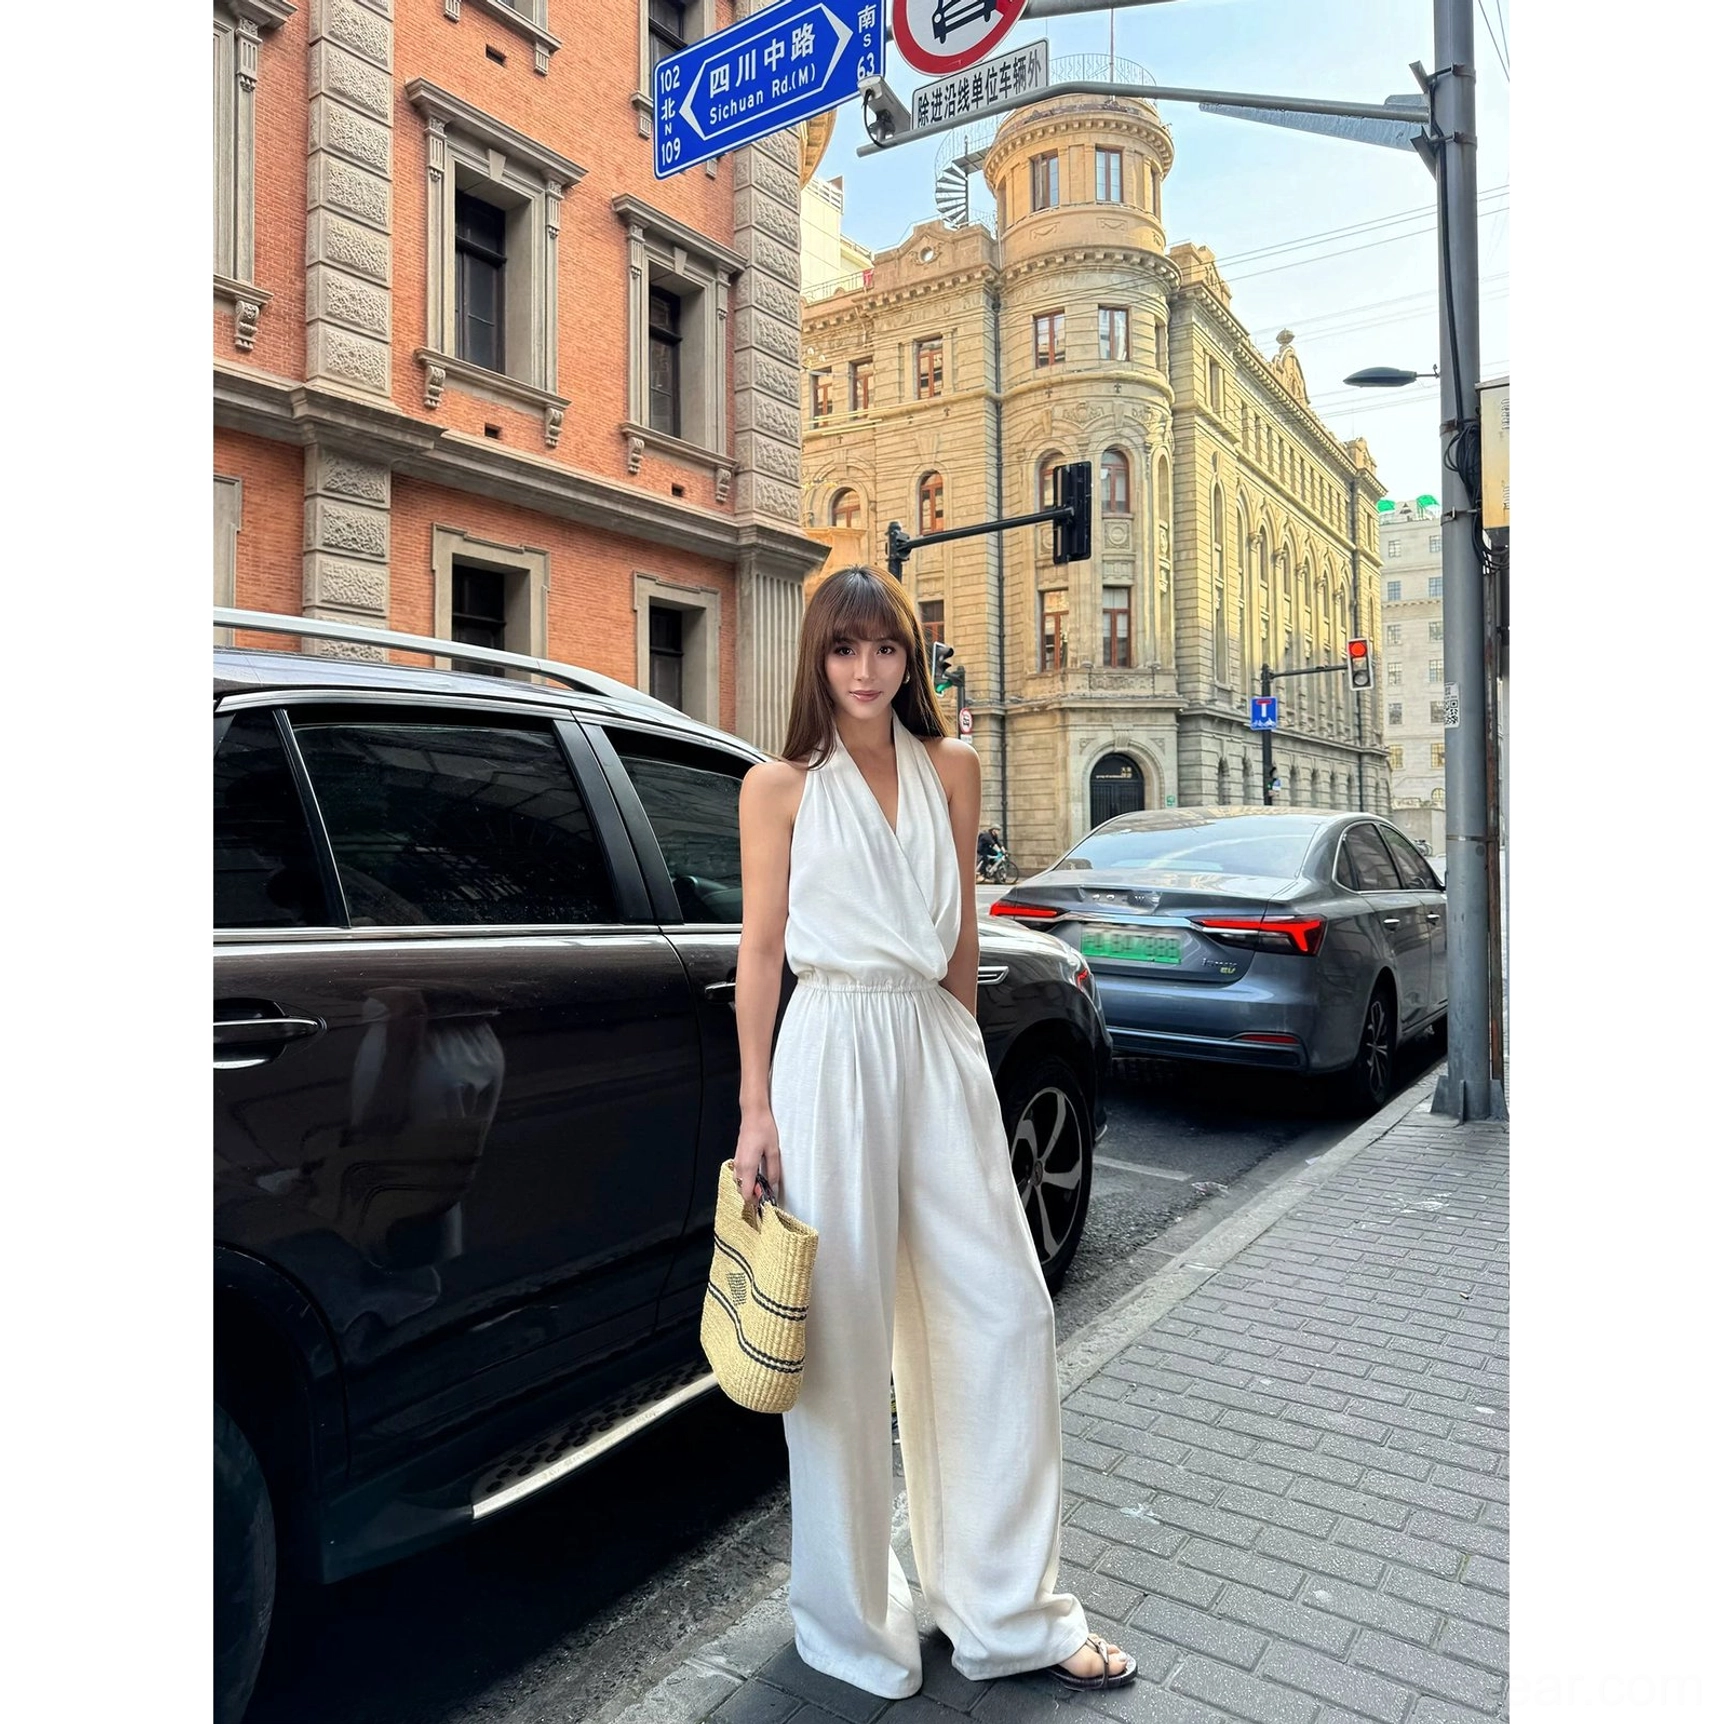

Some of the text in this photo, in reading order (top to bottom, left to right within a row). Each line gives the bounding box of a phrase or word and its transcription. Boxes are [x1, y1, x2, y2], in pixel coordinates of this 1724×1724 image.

[857, 4, 877, 33] 南
[863, 33, 871, 47] S
[709, 22, 815, 99] 四川中路
[857, 52, 875, 79] 63
[661, 64, 680, 94] 102
[709, 62, 816, 125] Sichuan Rd.(M)
[917, 49, 1042, 128] 除进沿线单位车辆外
[661, 97, 676, 121] 北
[664, 122, 672, 136] N
[661, 137, 681, 166] 109
